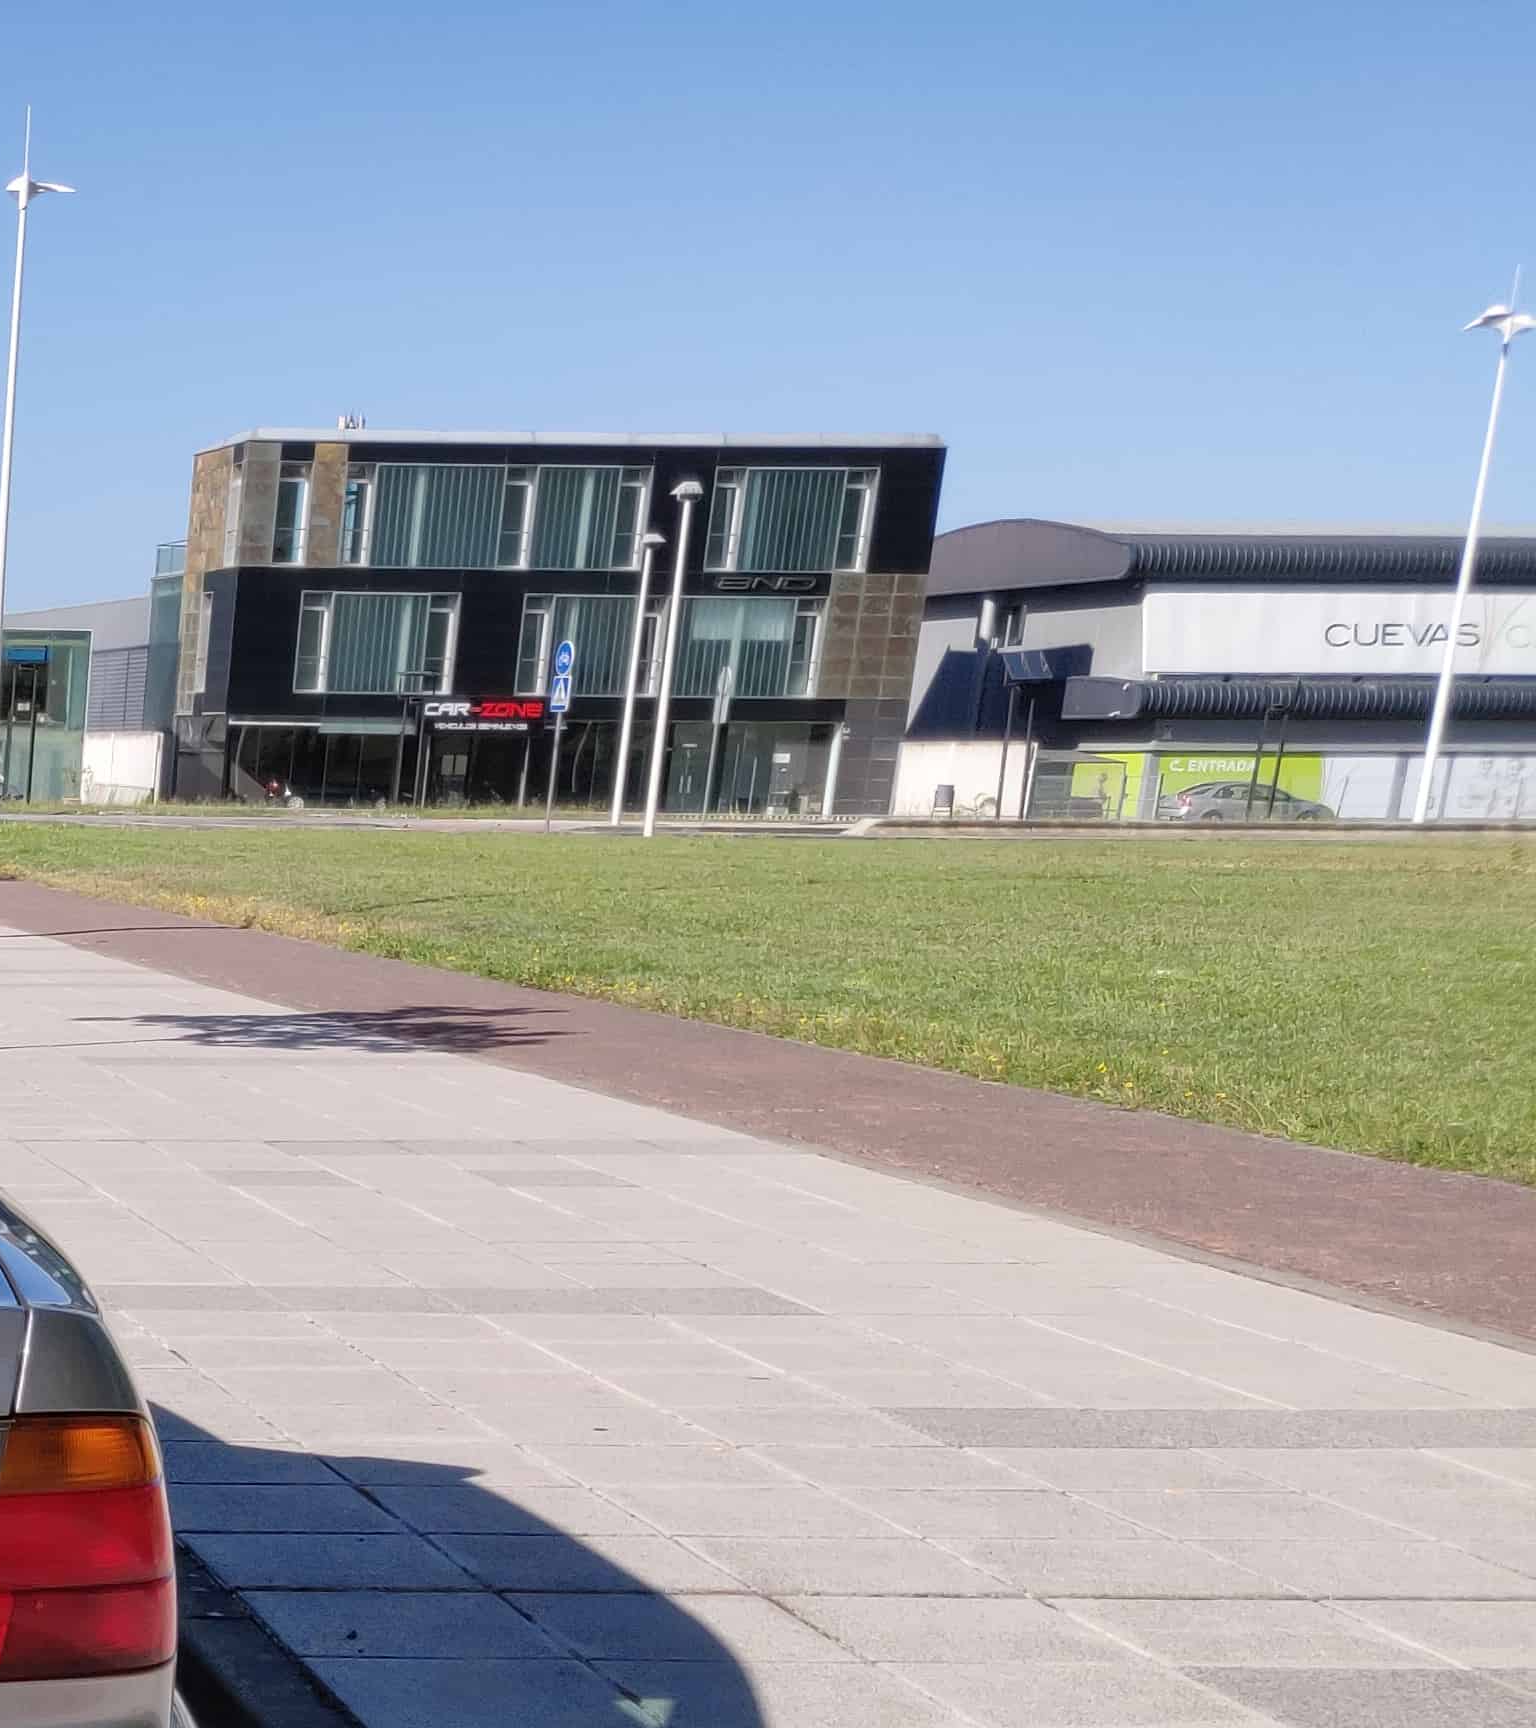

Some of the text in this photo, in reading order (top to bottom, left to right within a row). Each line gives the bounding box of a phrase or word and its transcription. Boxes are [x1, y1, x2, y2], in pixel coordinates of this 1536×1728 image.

[1324, 623, 1481, 648] CUEVAS
[424, 702, 544, 718] CAR-ZONE
[1188, 760, 1256, 772] ENTRADA
